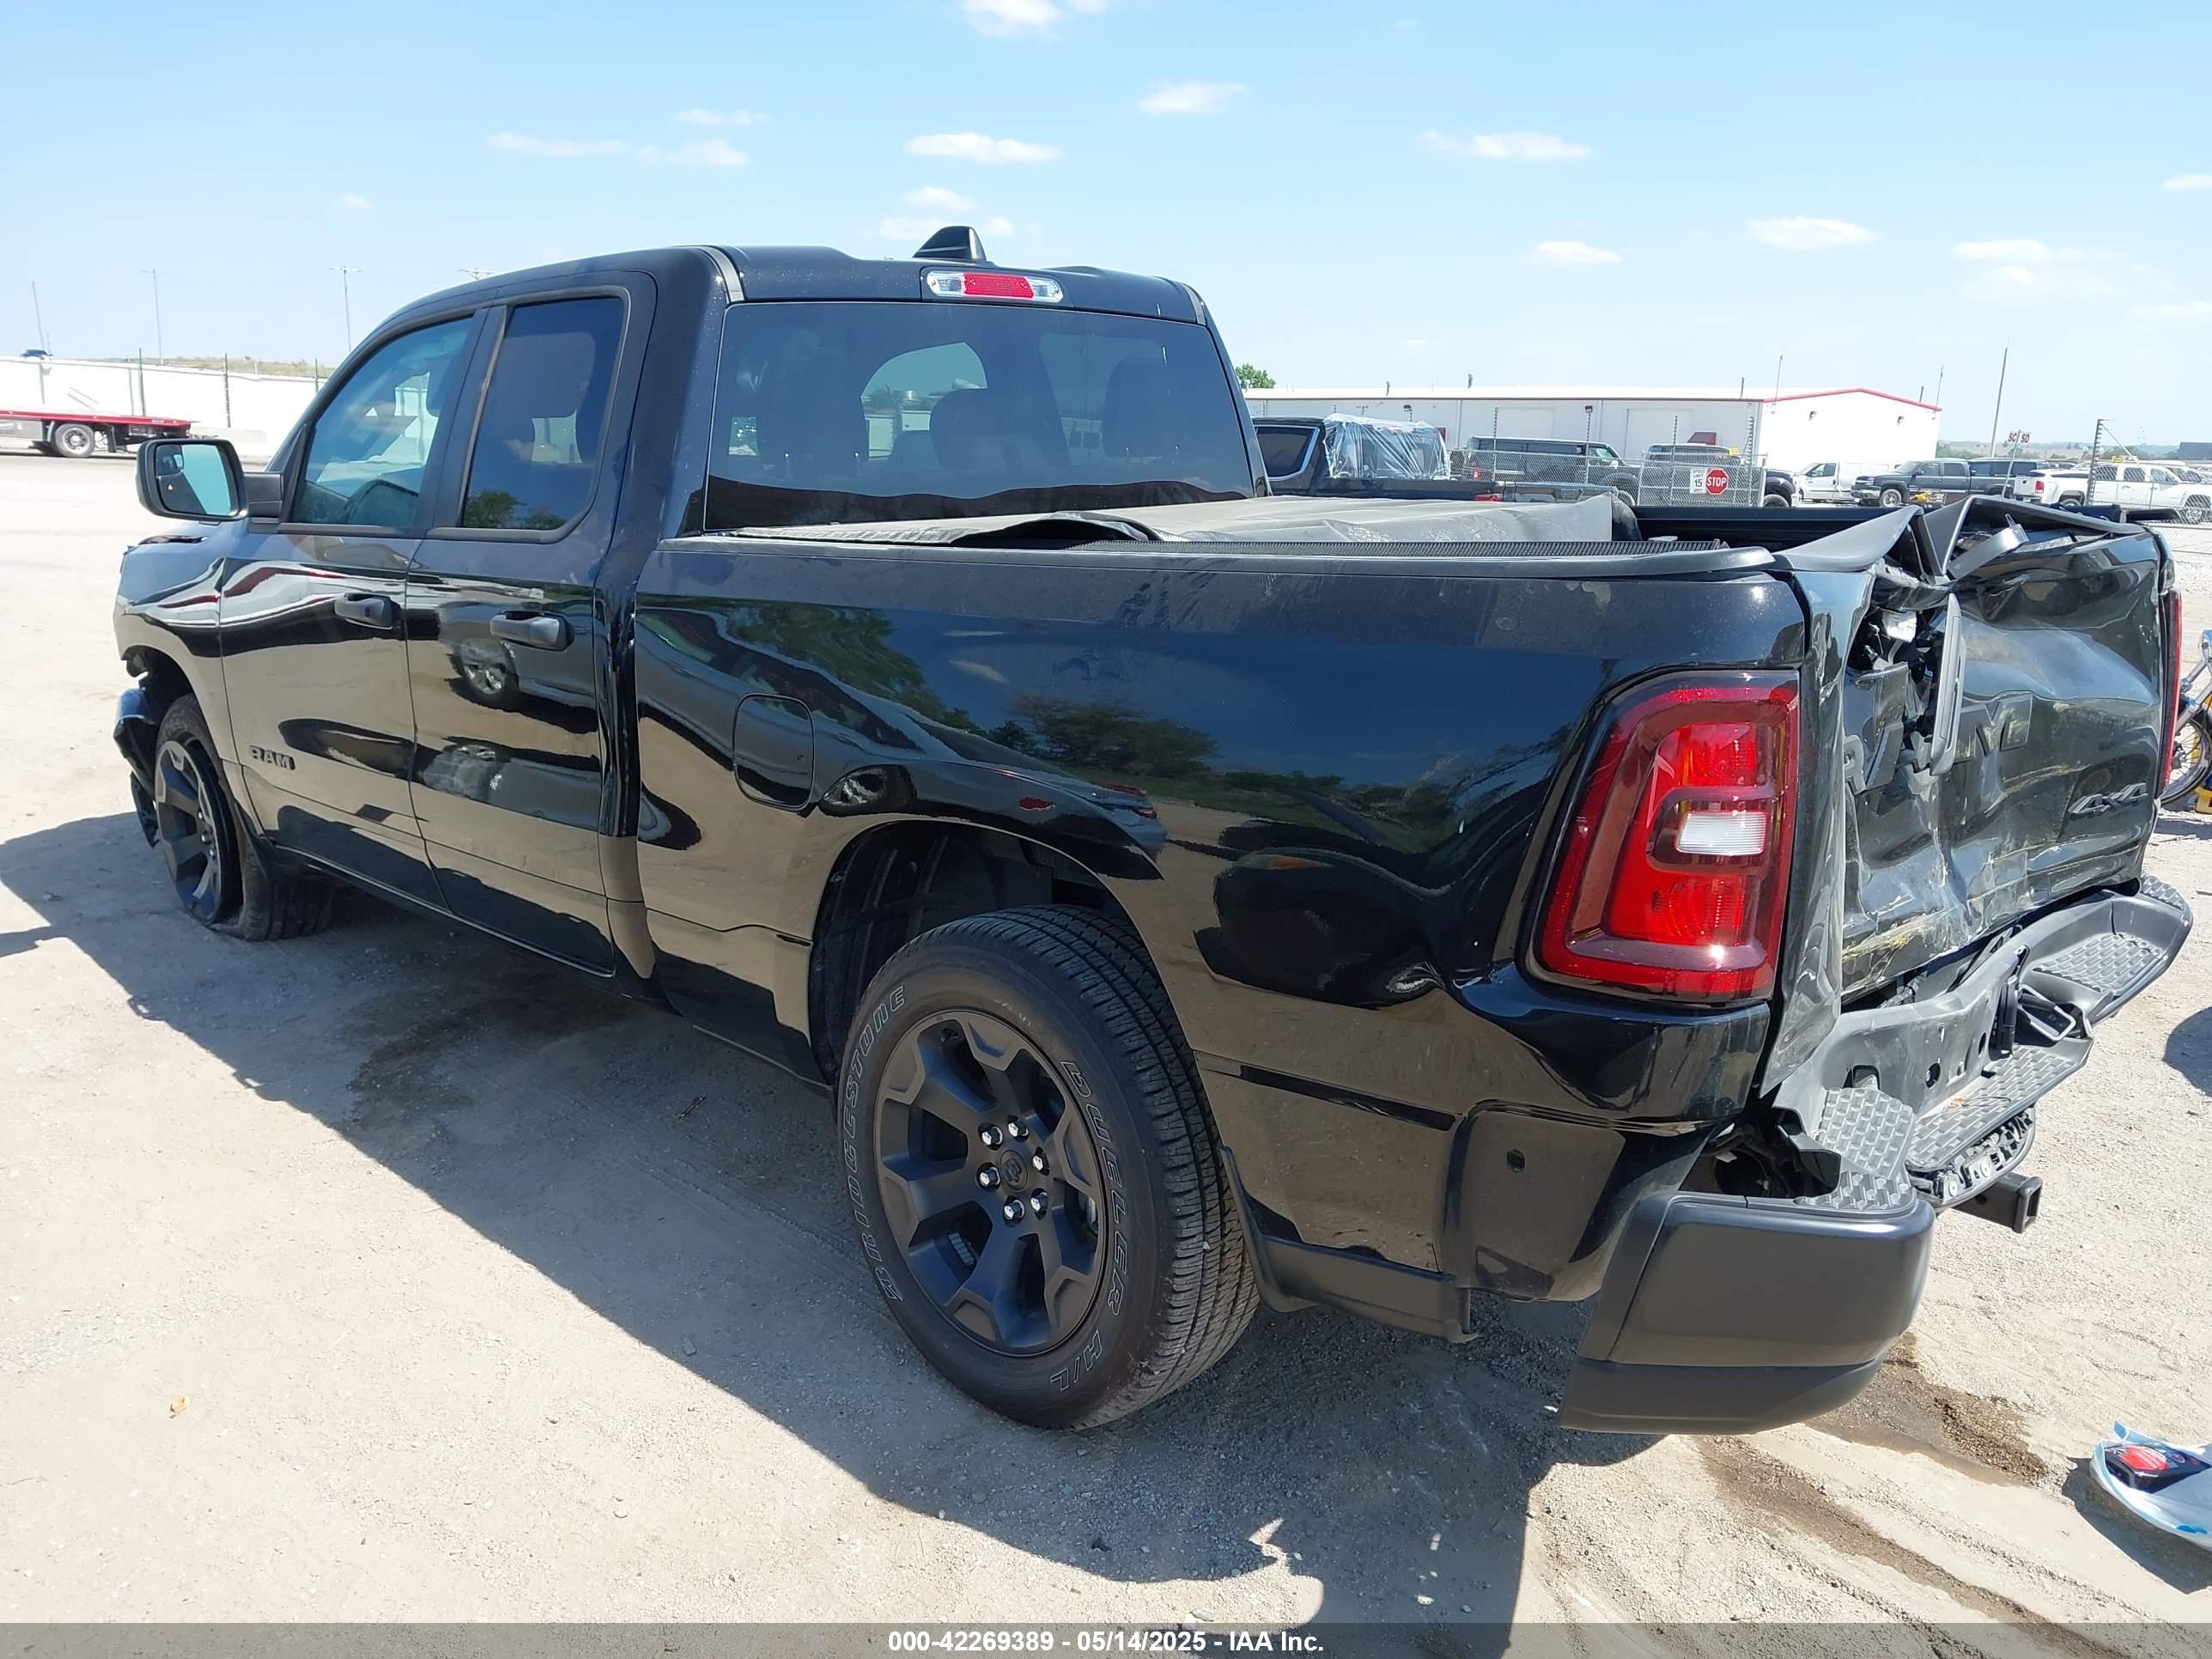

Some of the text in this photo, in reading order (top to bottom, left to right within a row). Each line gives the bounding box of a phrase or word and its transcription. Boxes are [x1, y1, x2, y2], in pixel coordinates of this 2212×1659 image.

[1694, 478, 1703, 487] 15
[1706, 477, 1727, 487] STOP
[247, 744, 296, 770] RAM
[843, 985, 905, 1302] BRIDGESTONE
[1050, 1060, 1128, 1393] DUELER H/L
